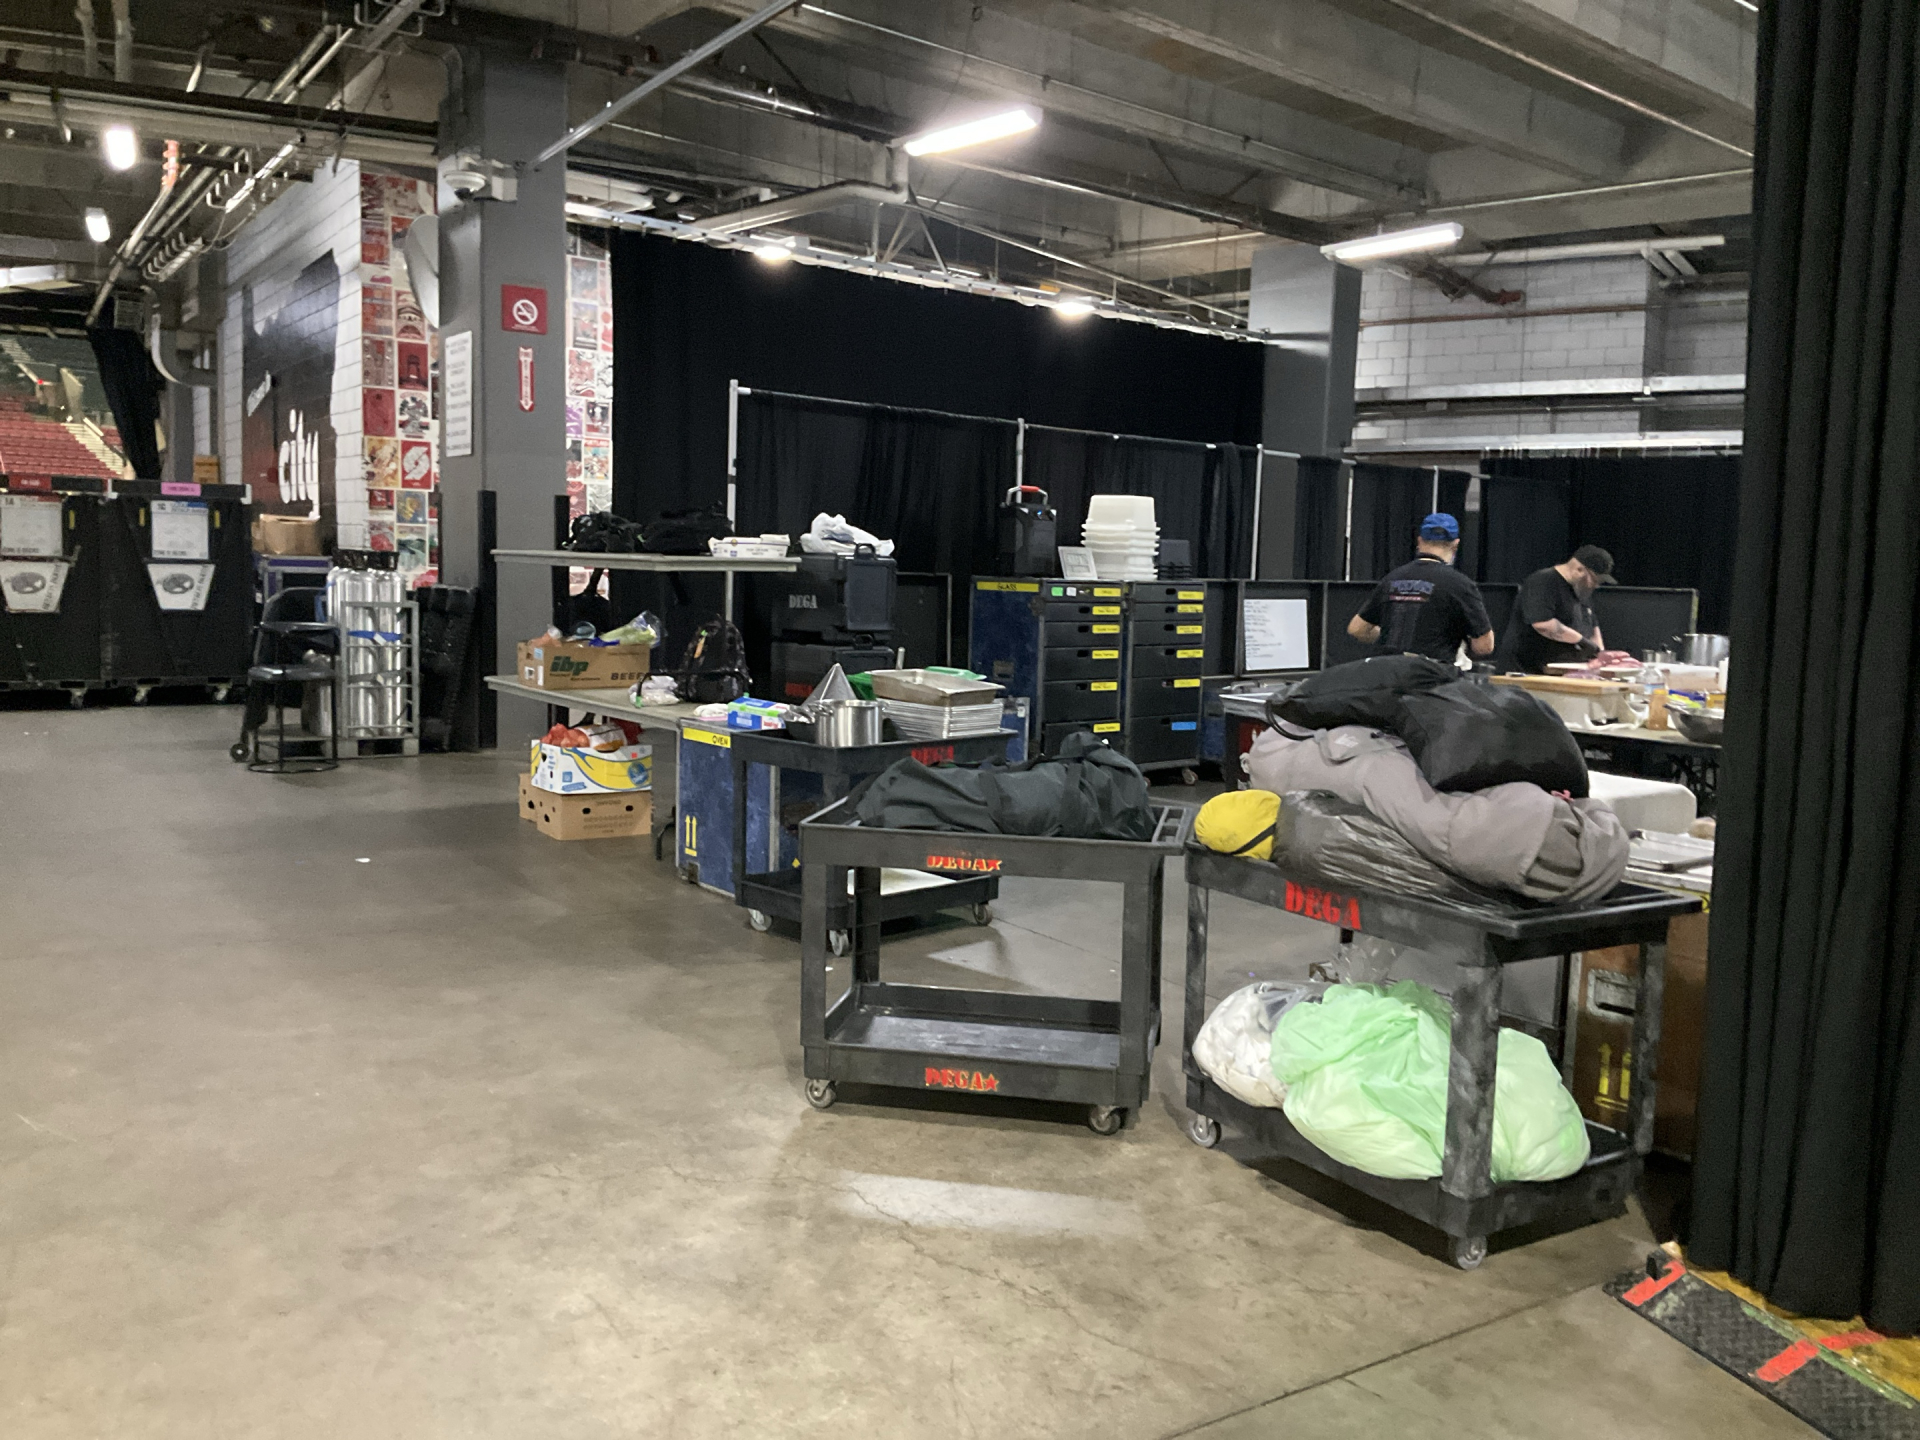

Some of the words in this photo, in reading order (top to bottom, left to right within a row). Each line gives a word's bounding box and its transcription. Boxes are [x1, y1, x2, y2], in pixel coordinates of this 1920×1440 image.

[278, 409, 320, 519] city
[788, 594, 818, 609] DEGA
[550, 656, 589, 676] ibp
[712, 735, 729, 746] OVEN
[1285, 879, 1362, 930] DEGA
[925, 1067, 985, 1091] DEGA
